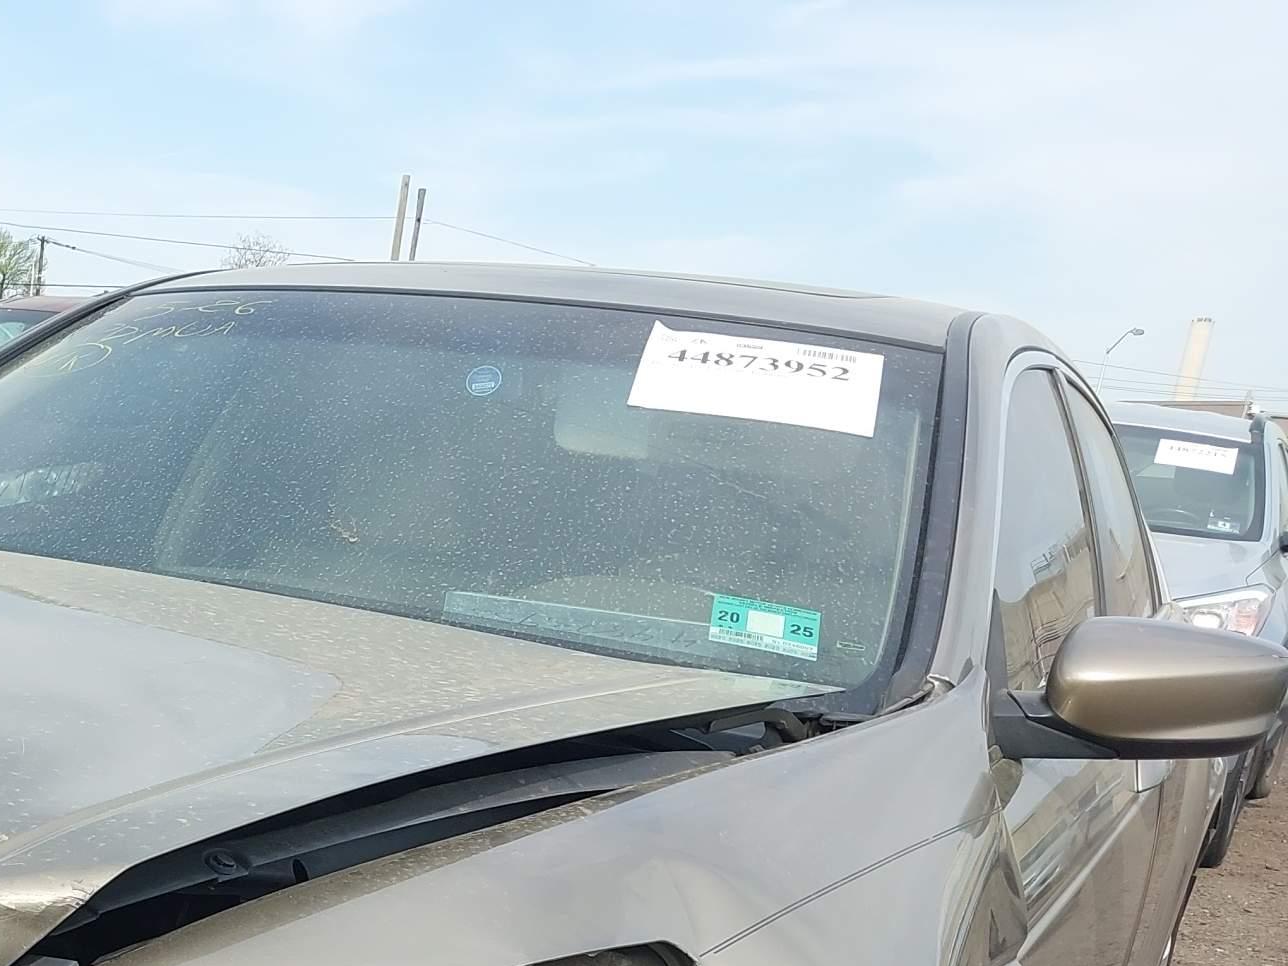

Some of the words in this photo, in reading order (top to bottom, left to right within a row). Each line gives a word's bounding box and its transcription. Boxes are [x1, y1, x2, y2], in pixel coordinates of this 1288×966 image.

[667, 348, 851, 382] 44873952
[717, 609, 741, 624] 20
[789, 623, 814, 638] 25
